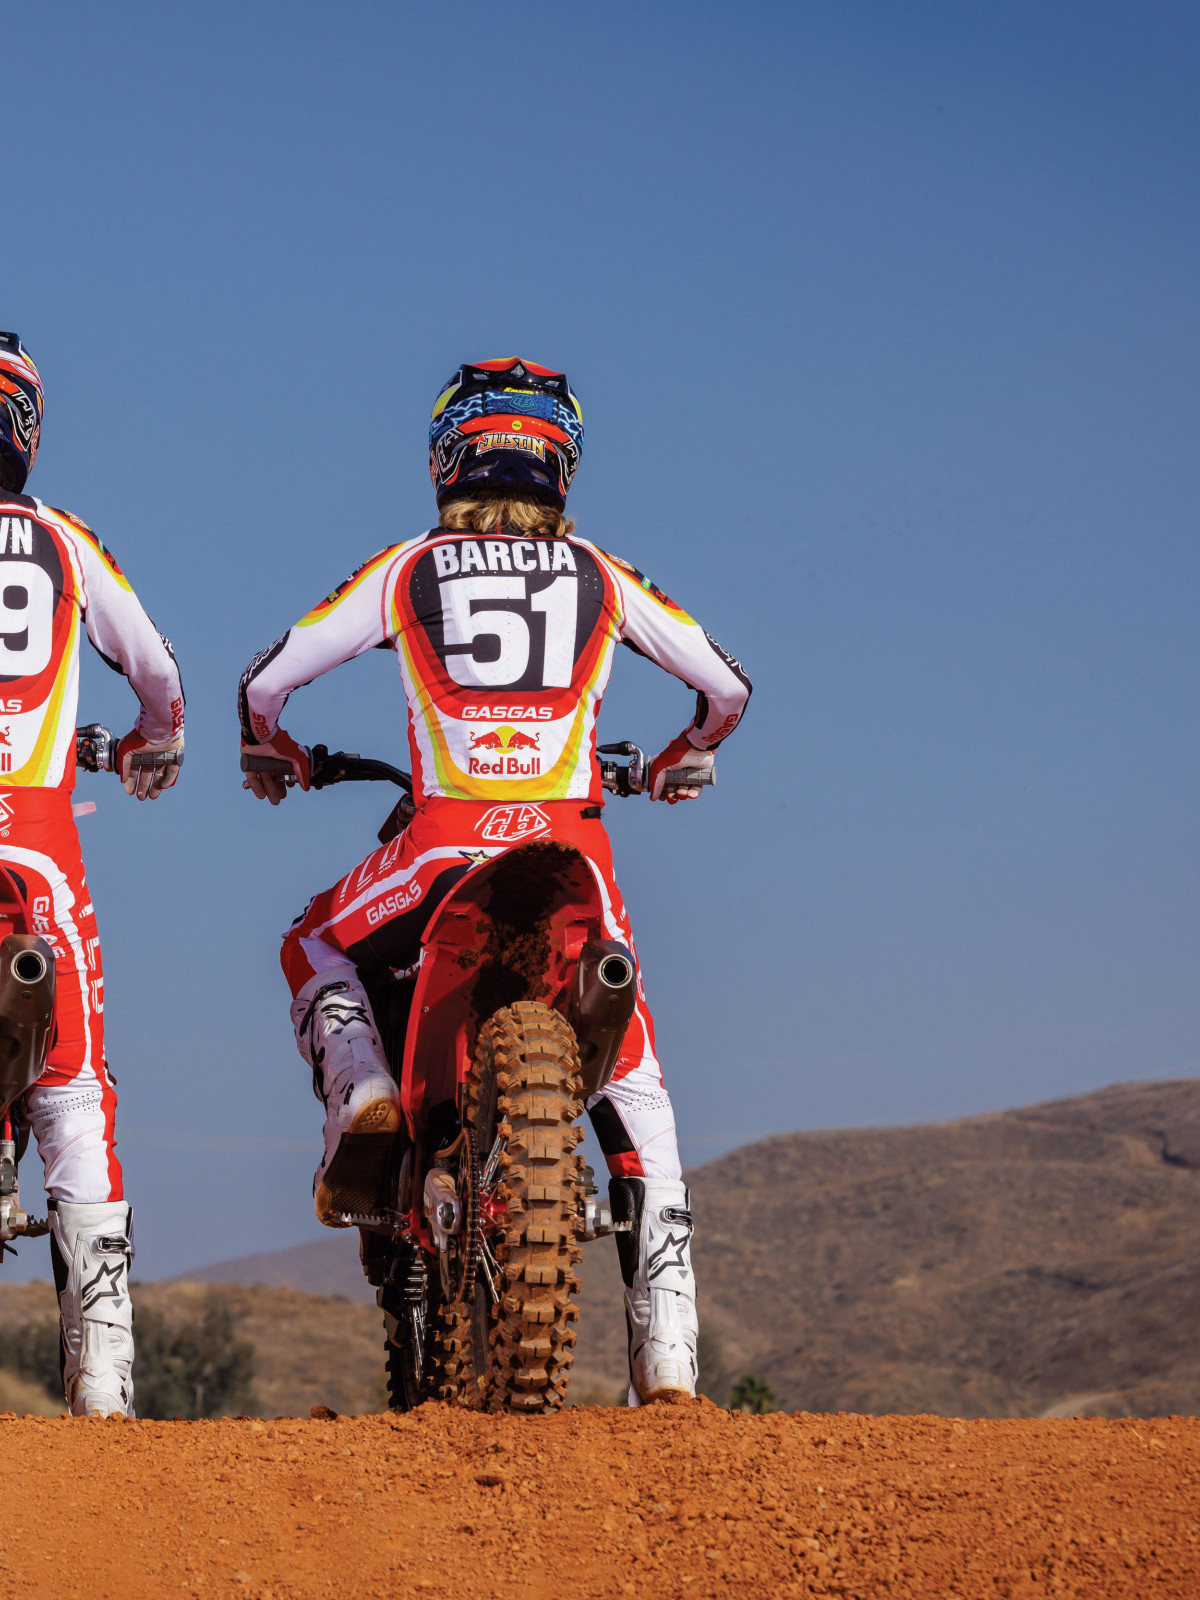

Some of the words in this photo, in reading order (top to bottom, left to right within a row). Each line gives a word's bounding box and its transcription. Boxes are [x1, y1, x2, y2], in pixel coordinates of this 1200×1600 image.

[479, 433, 546, 460] JUSTIN
[432, 541, 578, 578] BARCIA
[438, 575, 578, 689] 51
[461, 705, 553, 720] GASGAS
[469, 757, 505, 775] Red
[507, 757, 541, 775] Bull
[365, 880, 423, 926] GASGAS
